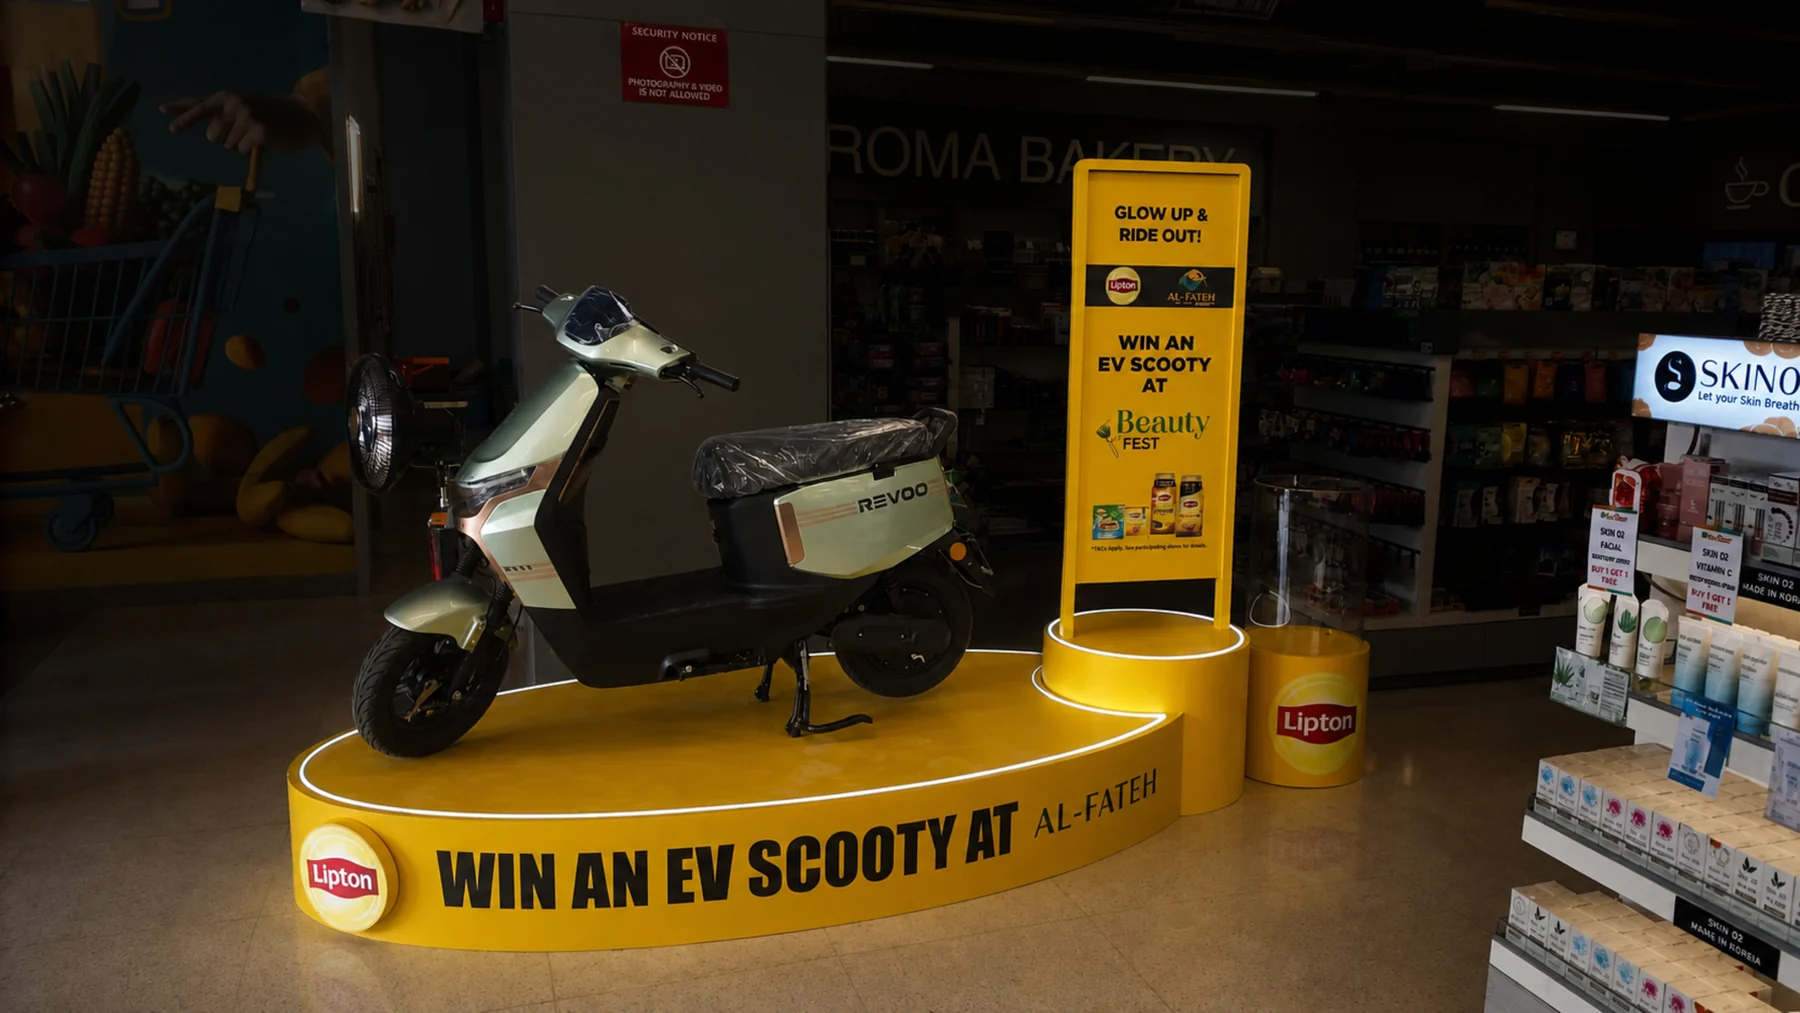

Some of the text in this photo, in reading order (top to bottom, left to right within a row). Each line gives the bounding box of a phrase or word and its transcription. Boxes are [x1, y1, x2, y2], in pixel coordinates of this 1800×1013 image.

[632, 26, 718, 42] SECURITY NOTICE
[628, 78, 689, 89] PHOTOGRAPHY
[699, 83, 723, 92] VIDEO
[639, 88, 710, 100] IS NOT ALLOWED
[828, 123, 1000, 181] ROMA
[1114, 205, 1209, 222] GLOW UP &
[1119, 228, 1202, 243] RIDE OUT!
[1110, 280, 1136, 290] Lipton
[1167, 292, 1216, 302] AL-FATEH
[1118, 335, 1194, 351] WIN AN
[1098, 357, 1212, 372] EV SCOOTY
[1142, 378, 1168, 393] AT
[1698, 391, 1713, 401] Let
[1715, 394, 1738, 404] your
[1740, 395, 1761, 407] Skin
[1117, 409, 1210, 440] Beauty
[1123, 437, 1160, 450] FEST
[858, 482, 928, 513] REVOO
[1600, 527, 1615, 538] SKIN
[1135, 544, 1166, 552] participating
[1702, 548, 1719, 560] SKIN
[1591, 565, 1604, 574] BUY
[1610, 567, 1624, 577] GET
[1696, 561, 1733, 577] VITAMIN C
[1601, 577, 1618, 586] FREE
[1757, 572, 1780, 585] SKIN
[1691, 588, 1705, 598] BUY
[1711, 593, 1726, 604] GET
[1742, 583, 1765, 596] MADE
[1767, 589, 1777, 598] IN
[1701, 601, 1719, 613] FREE
[1284, 711, 1352, 736] Lipton
[436, 768, 1158, 910] WIN AN EV SCOOTY AT AL-FATEH
[312, 863, 373, 893] Lipton
[1707, 918, 1729, 935] SKIN
[1717, 937, 1727, 948] IN
